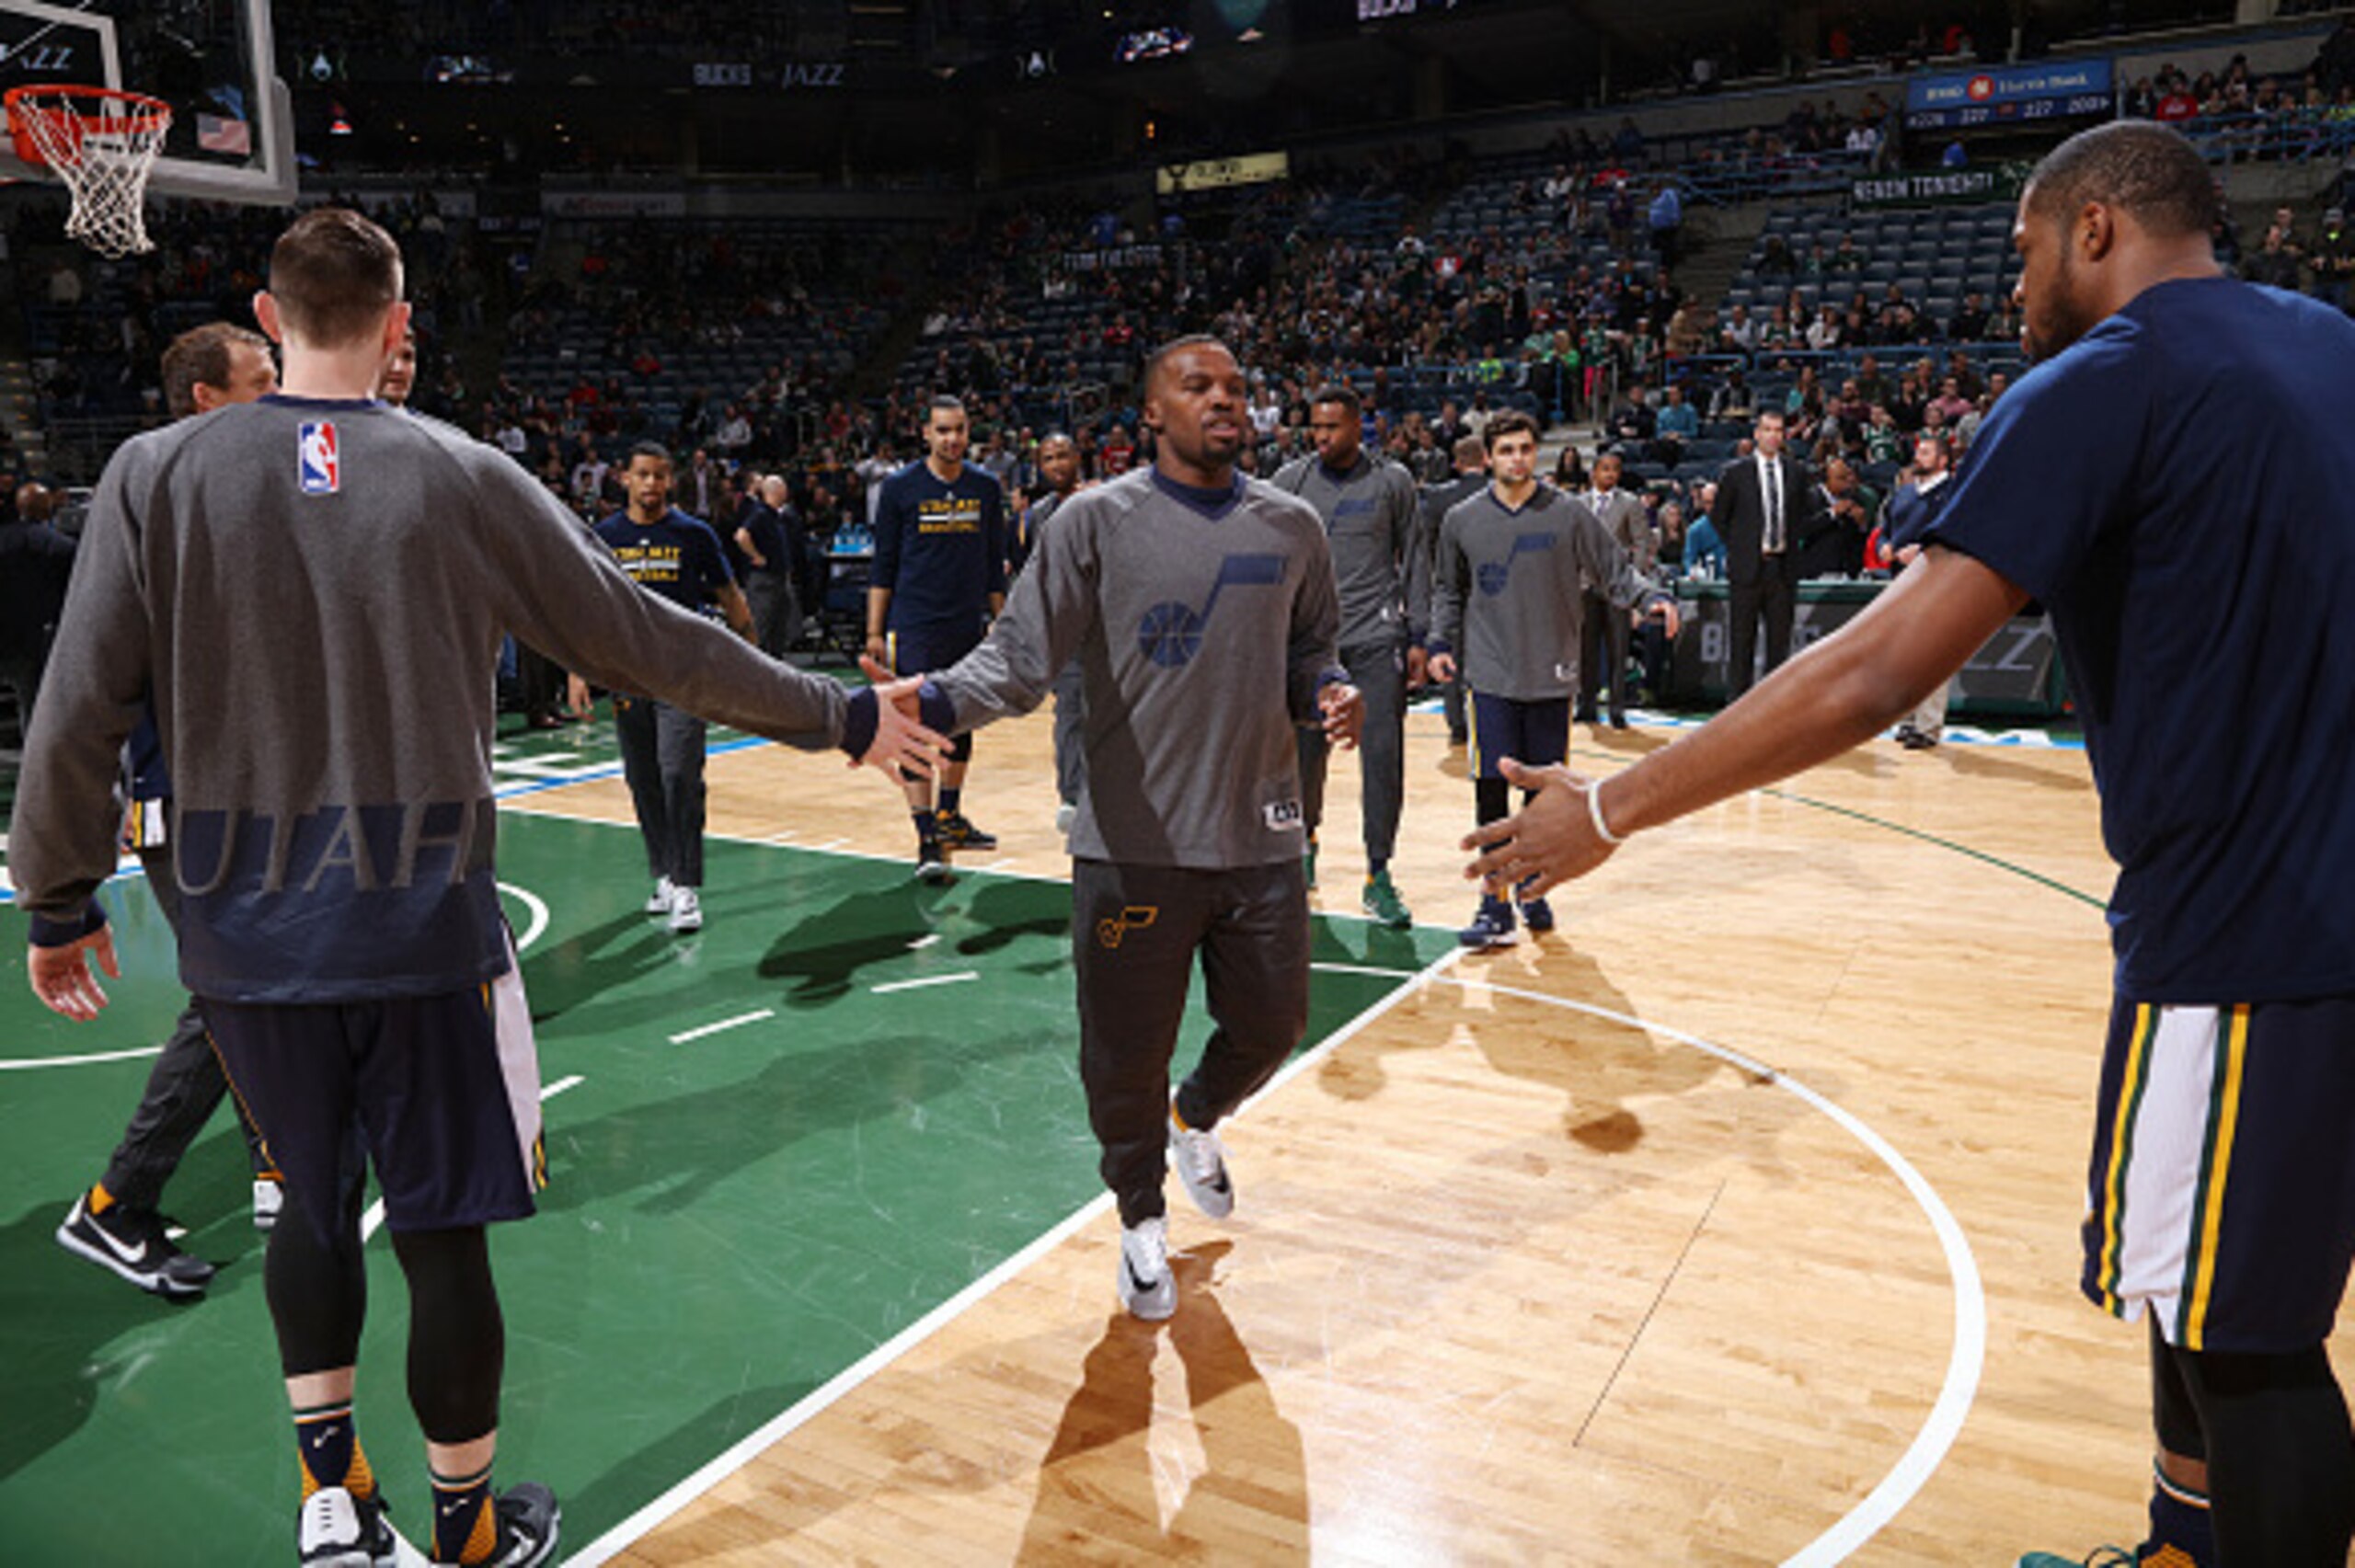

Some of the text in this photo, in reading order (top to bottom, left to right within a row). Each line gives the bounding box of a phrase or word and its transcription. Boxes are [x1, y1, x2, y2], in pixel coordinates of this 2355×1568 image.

[693, 63, 844, 89] BUCKS JAZZ
[173, 802, 477, 896] UTAH
